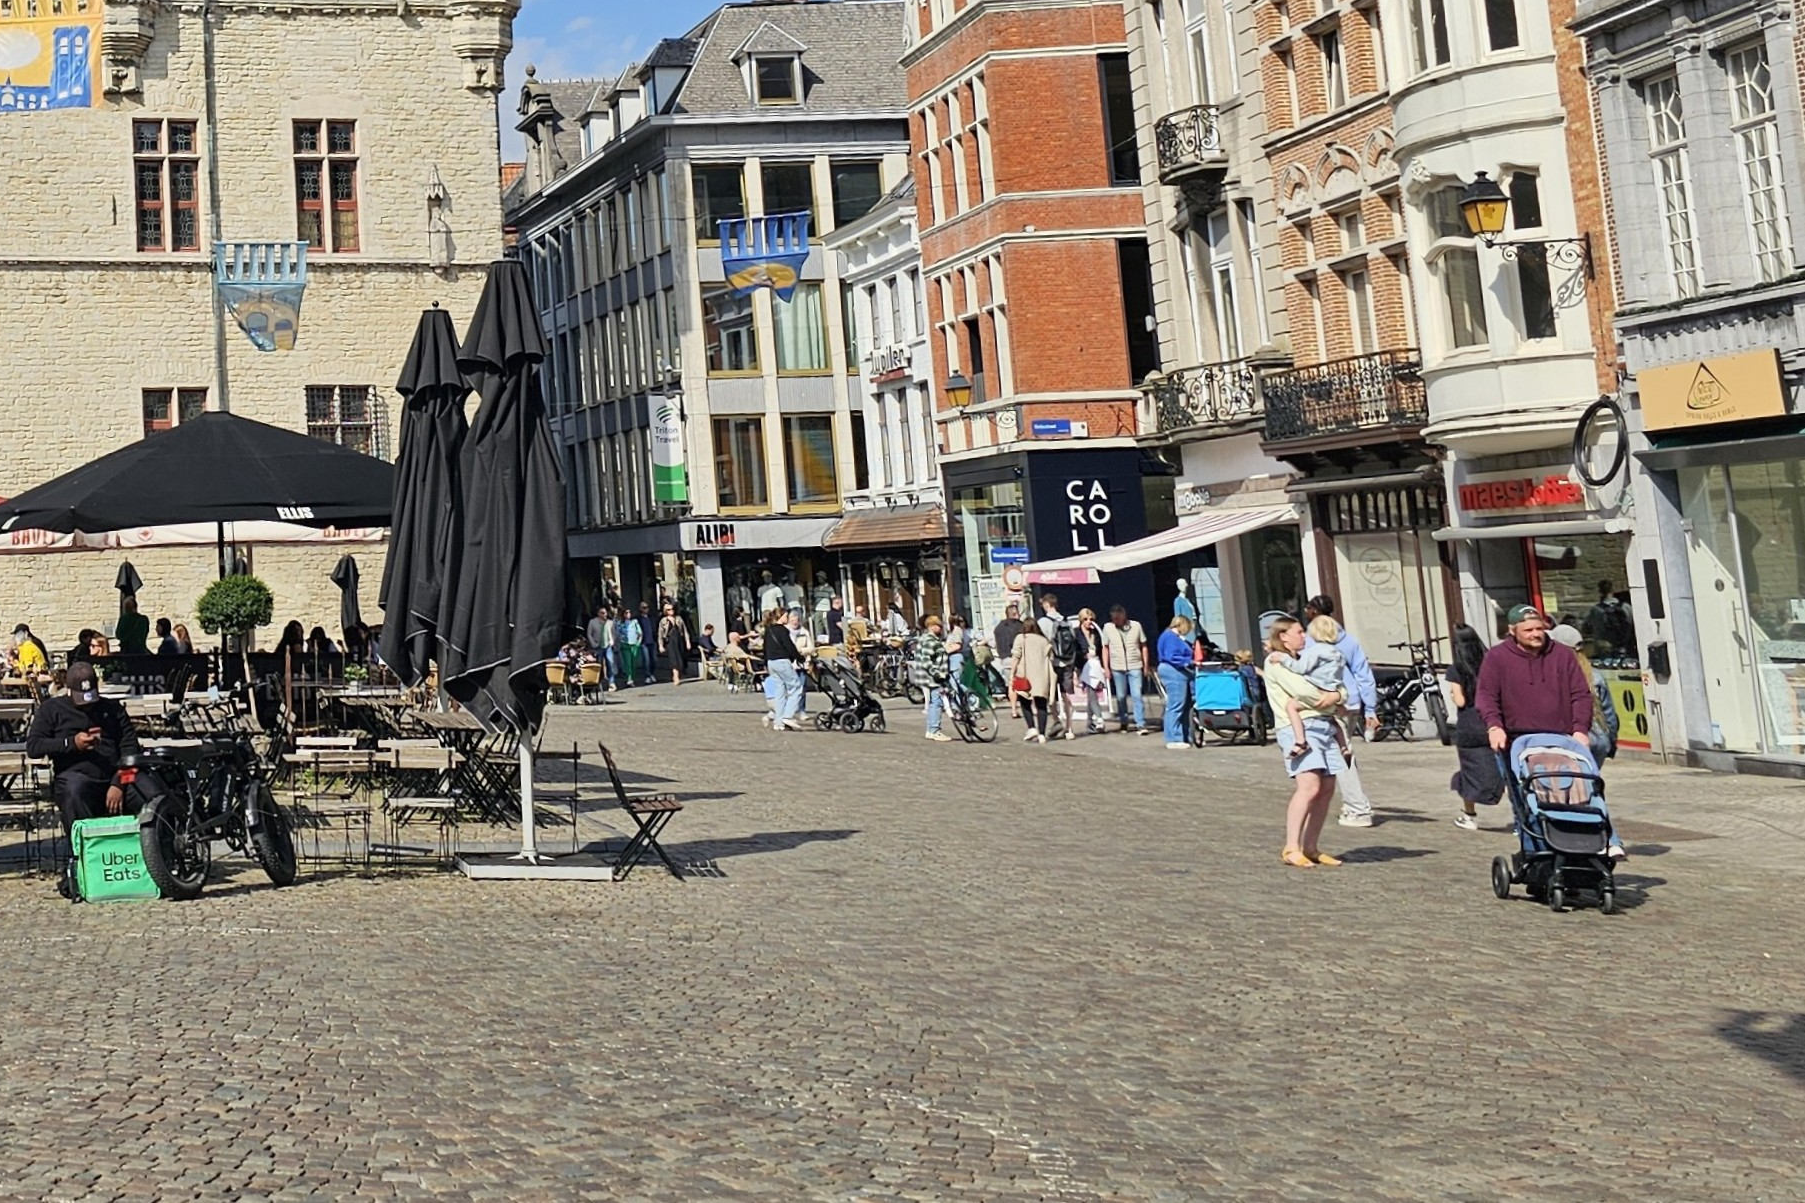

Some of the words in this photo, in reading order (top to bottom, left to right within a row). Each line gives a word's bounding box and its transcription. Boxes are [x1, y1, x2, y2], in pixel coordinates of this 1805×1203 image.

[655, 426, 678, 434] Triton
[655, 435, 679, 443] Travel
[1459, 480, 1519, 511] maes
[276, 506, 314, 519] ELLIS
[696, 524, 736, 545] ALIBI
[101, 851, 139, 866] Uber
[103, 867, 141, 882] Eats
